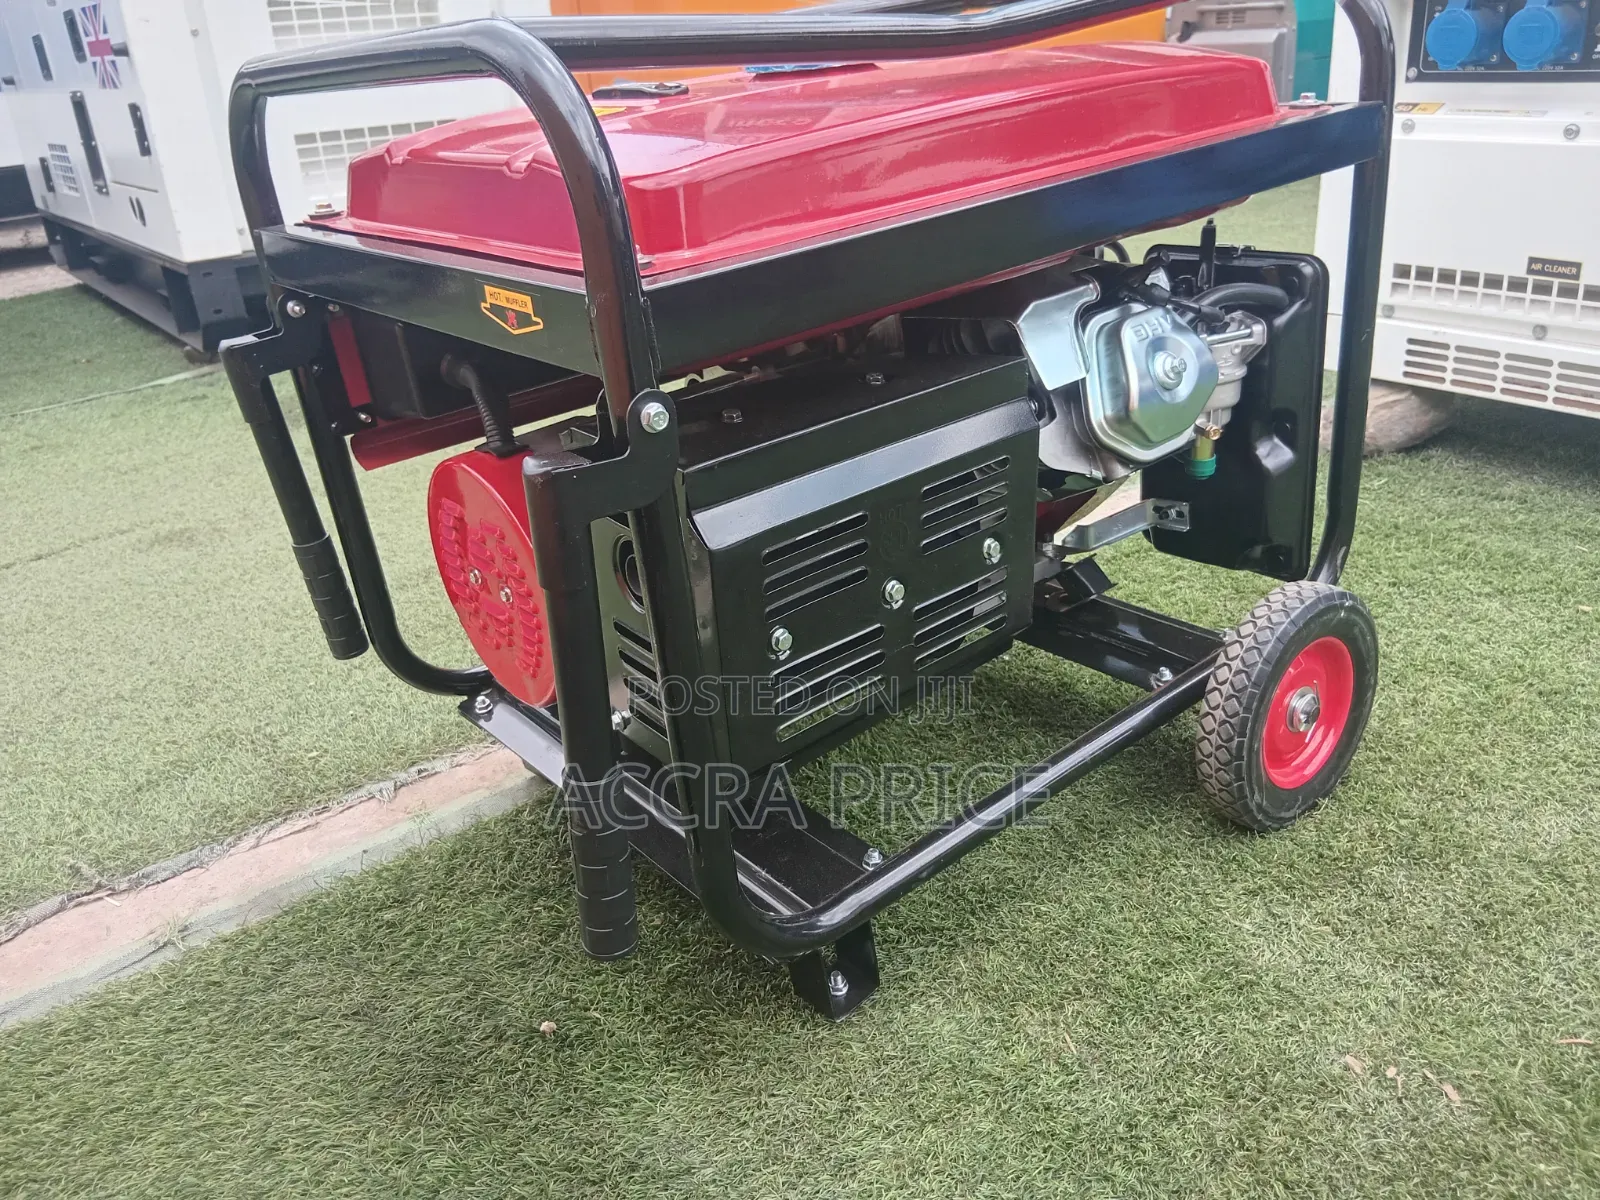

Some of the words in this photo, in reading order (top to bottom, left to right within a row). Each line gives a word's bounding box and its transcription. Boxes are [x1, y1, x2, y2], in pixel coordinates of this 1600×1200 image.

[1530, 262, 1543, 271] AIR
[1544, 264, 1577, 275] CLEANER
[505, 297, 528, 309] MUFFLER
[1131, 314, 1173, 343] OHV
